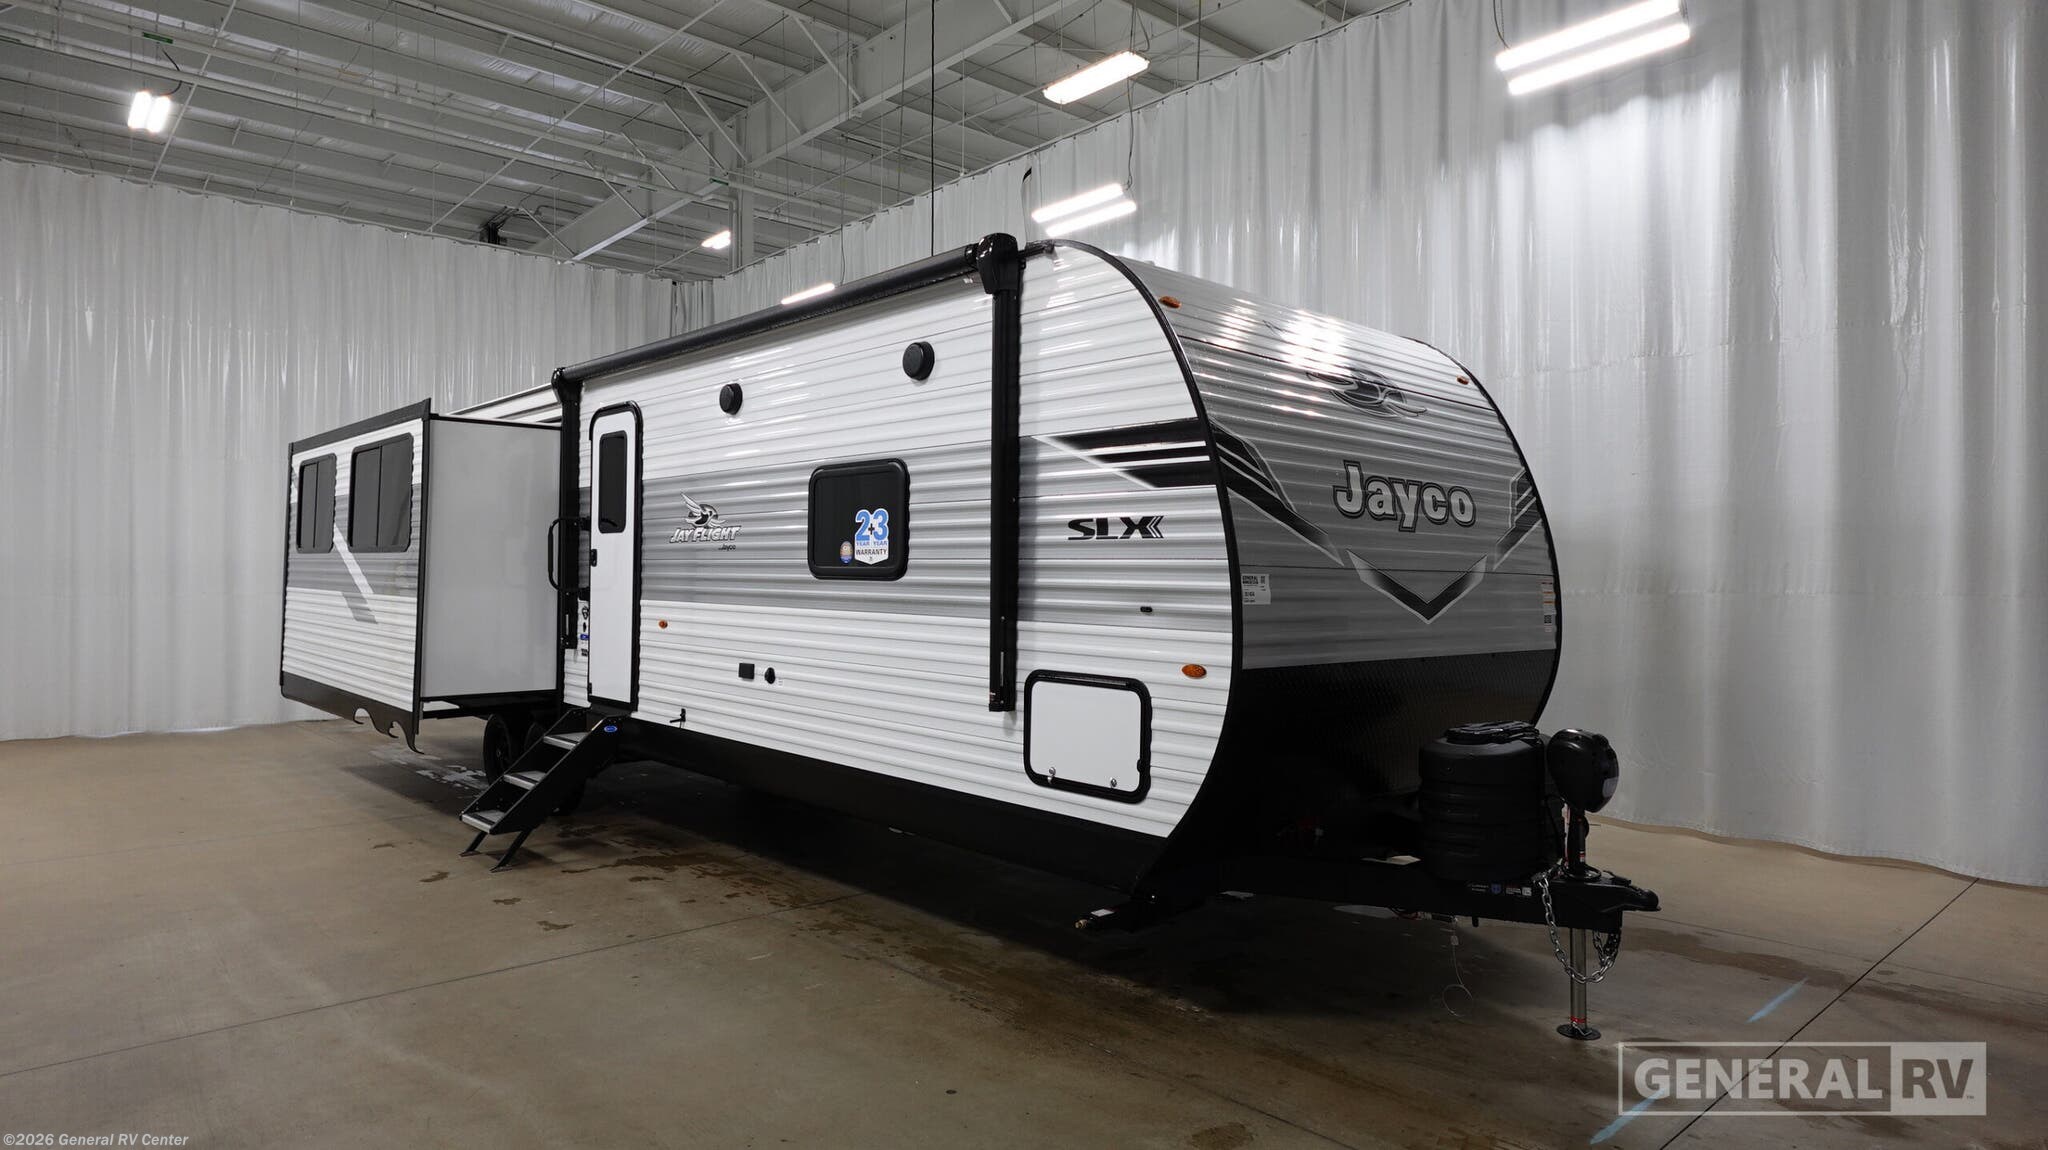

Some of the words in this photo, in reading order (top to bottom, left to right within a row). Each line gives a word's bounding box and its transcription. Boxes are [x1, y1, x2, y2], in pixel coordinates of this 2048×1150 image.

[1332, 459, 1476, 533] Jayco
[669, 528, 693, 543] JAY
[692, 526, 741, 542] FLIGHT
[1067, 515, 1164, 541] SLX
